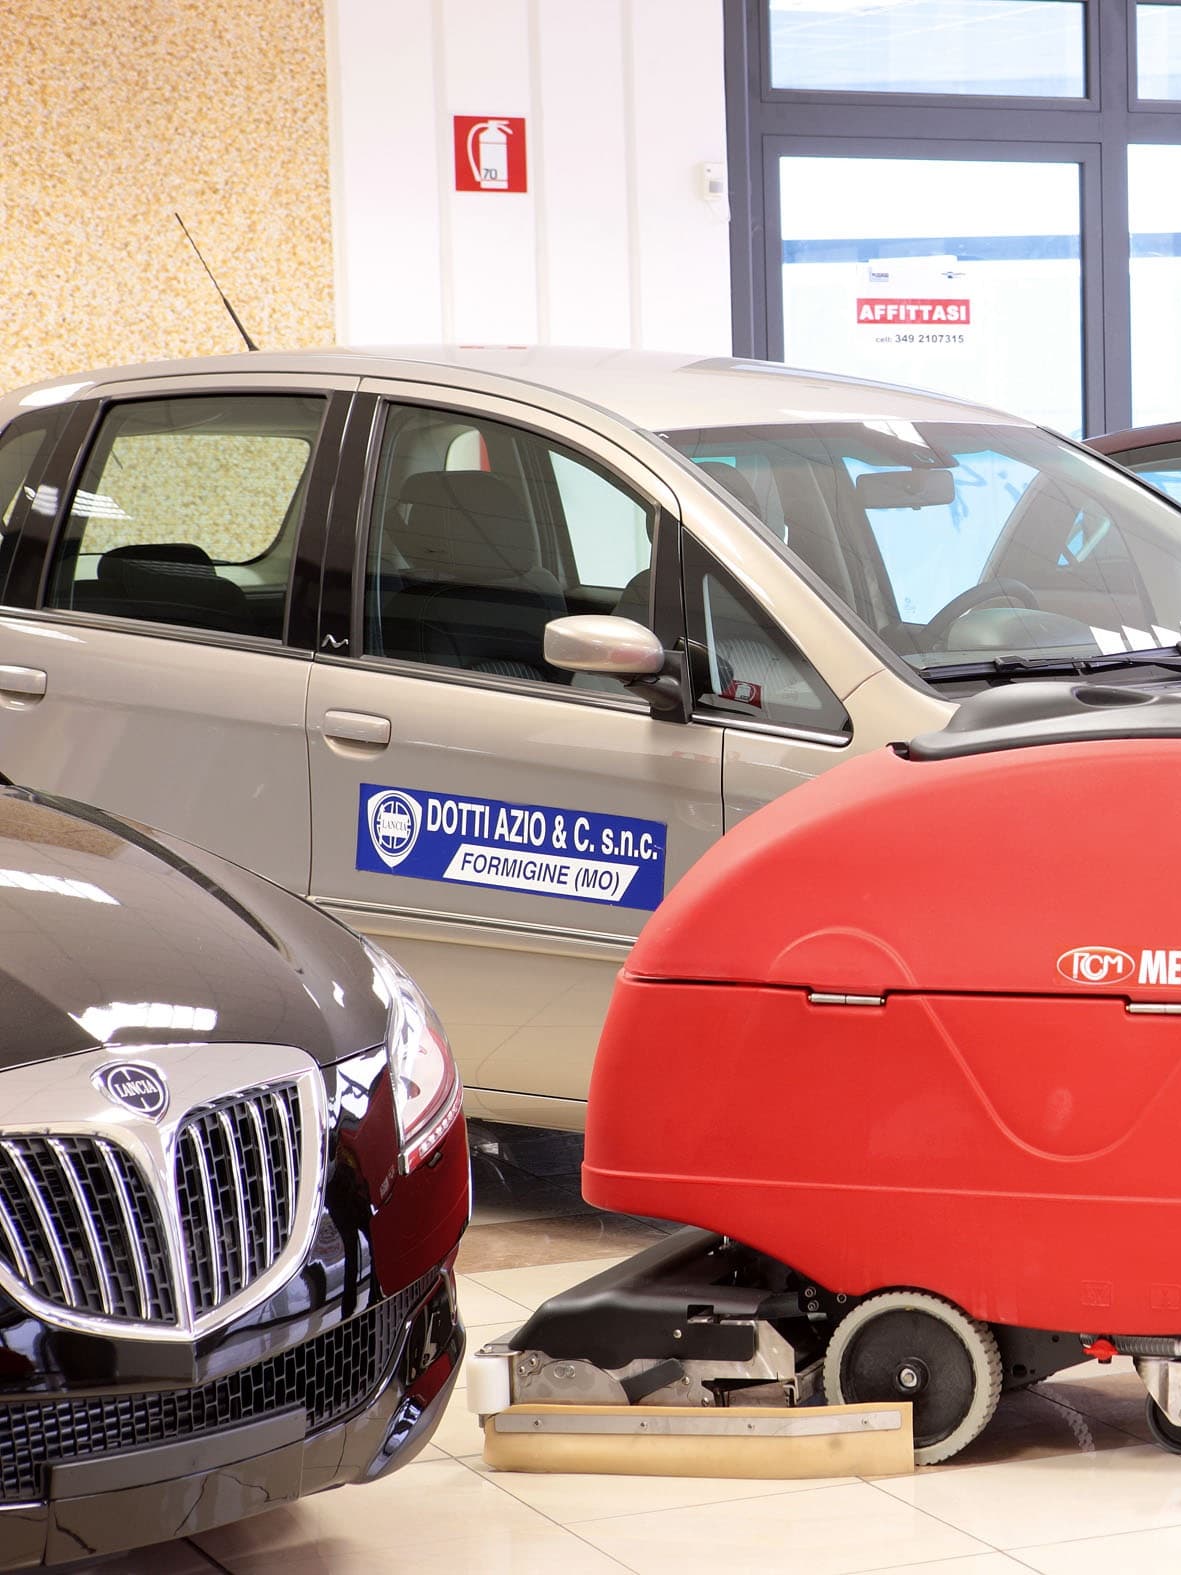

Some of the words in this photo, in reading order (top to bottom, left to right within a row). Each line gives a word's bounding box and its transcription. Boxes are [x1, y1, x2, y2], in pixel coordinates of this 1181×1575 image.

[483, 168, 498, 180] 70
[859, 304, 967, 321] AFFITTASI
[895, 334, 915, 343] 349
[918, 334, 965, 344] 2107315
[382, 819, 407, 832] LANCIA
[427, 798, 490, 839] DOTTI
[493, 807, 546, 847] AZIO
[551, 814, 567, 849] &
[573, 816, 595, 853] C.
[601, 828, 658, 861] s.n.c.
[461, 852, 571, 885] FORMIGINE
[574, 867, 620, 897] (MO)
[114, 1079, 158, 1098] LANCIA
